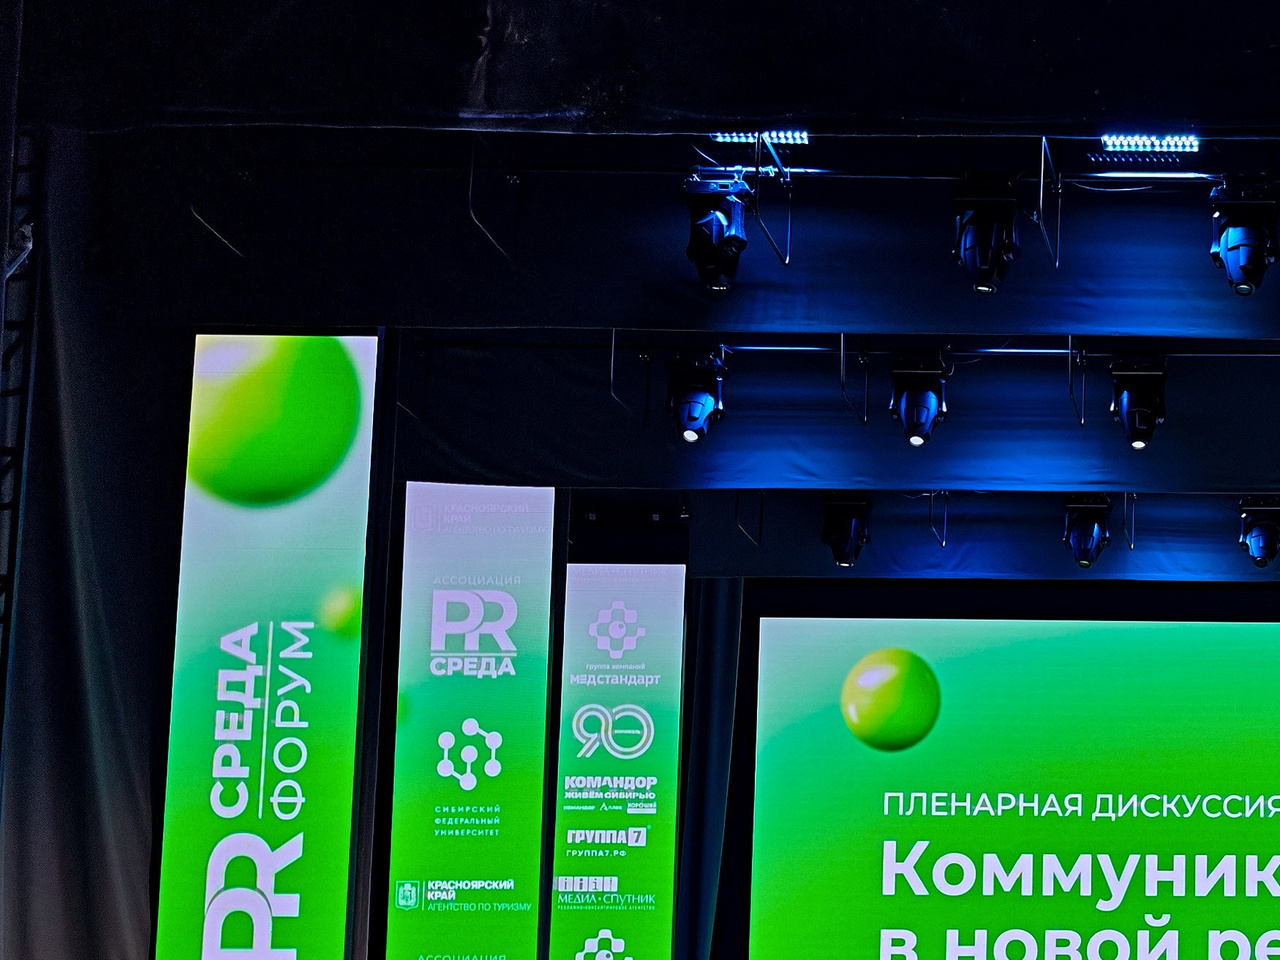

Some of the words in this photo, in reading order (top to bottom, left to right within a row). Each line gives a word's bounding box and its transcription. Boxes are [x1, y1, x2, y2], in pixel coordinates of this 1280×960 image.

[433, 576, 521, 586] АССОЦИАЦИЯ
[430, 589, 518, 651] PR
[429, 657, 516, 678] СРЕДА
[210, 621, 267, 818] СРЕДА
[270, 621, 315, 820] ФОРУМ
[565, 776, 658, 790] КОМАНДОР
[434, 804, 500, 813] СИБИРСКИЙ
[883, 793, 1082, 817] ПЛЕНАРНАЯ
[434, 816, 500, 825] ФЕДЕРАЛЬНЫЙ
[567, 830, 627, 843] ГРУППА
[427, 879, 514, 890] КРАСНОЯРСКИЙ
[427, 889, 456, 900] КРАЙ
[428, 903, 476, 911] АГЕНТСТВО
[478, 903, 491, 911] ПО
[493, 903, 532, 911] ТУРИЗМУ
